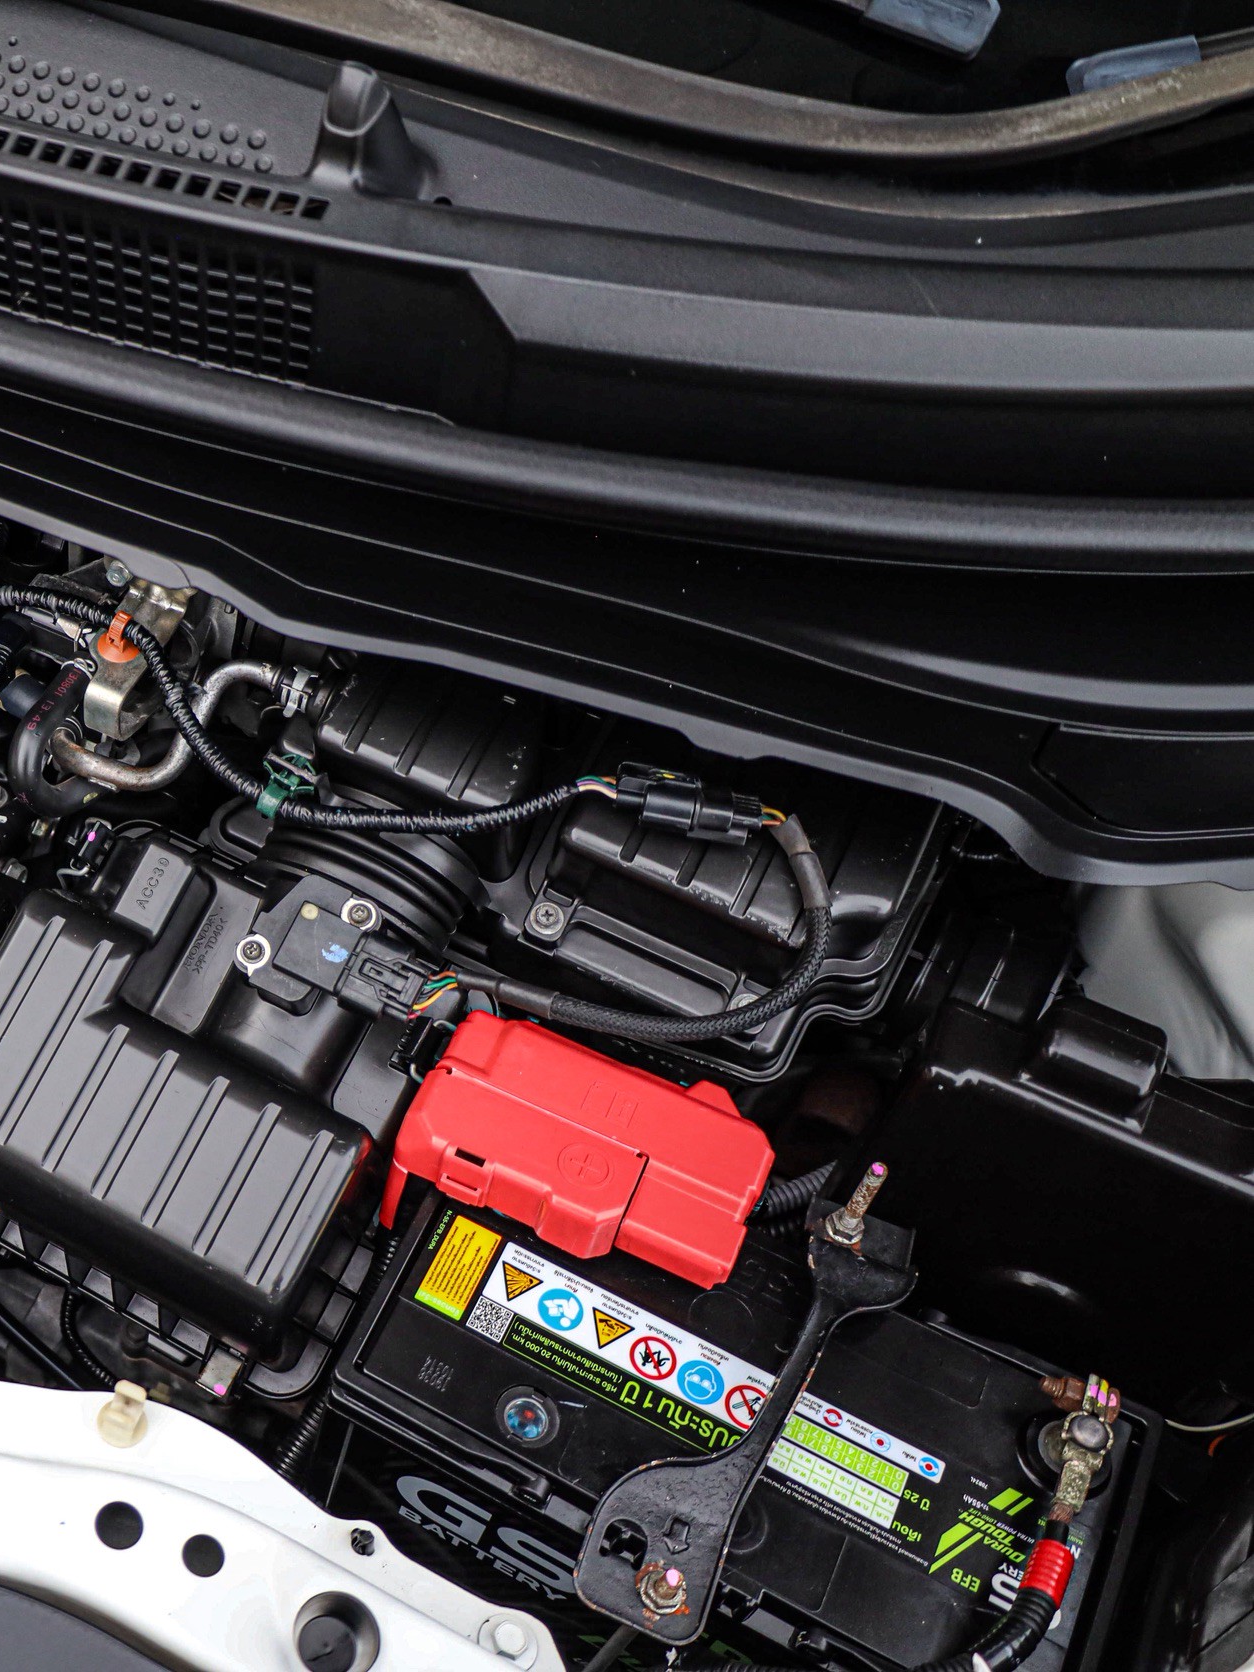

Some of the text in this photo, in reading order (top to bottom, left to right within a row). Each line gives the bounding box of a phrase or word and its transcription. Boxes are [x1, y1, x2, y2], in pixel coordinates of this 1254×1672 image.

[507, 1330, 526, 1346] km.
[523, 1338, 553, 1359] 20,000
[901, 1487, 920, 1504] 25
[397, 1475, 577, 1594] GS
[888, 1519, 923, 1545] เดือน
[957, 1509, 1015, 1546] TOUGH
[995, 1520, 1017, 1535] POWER
[398, 1506, 567, 1601] BATTERY
[980, 1534, 1026, 1565] DURA
[950, 1567, 982, 1593] EFB
